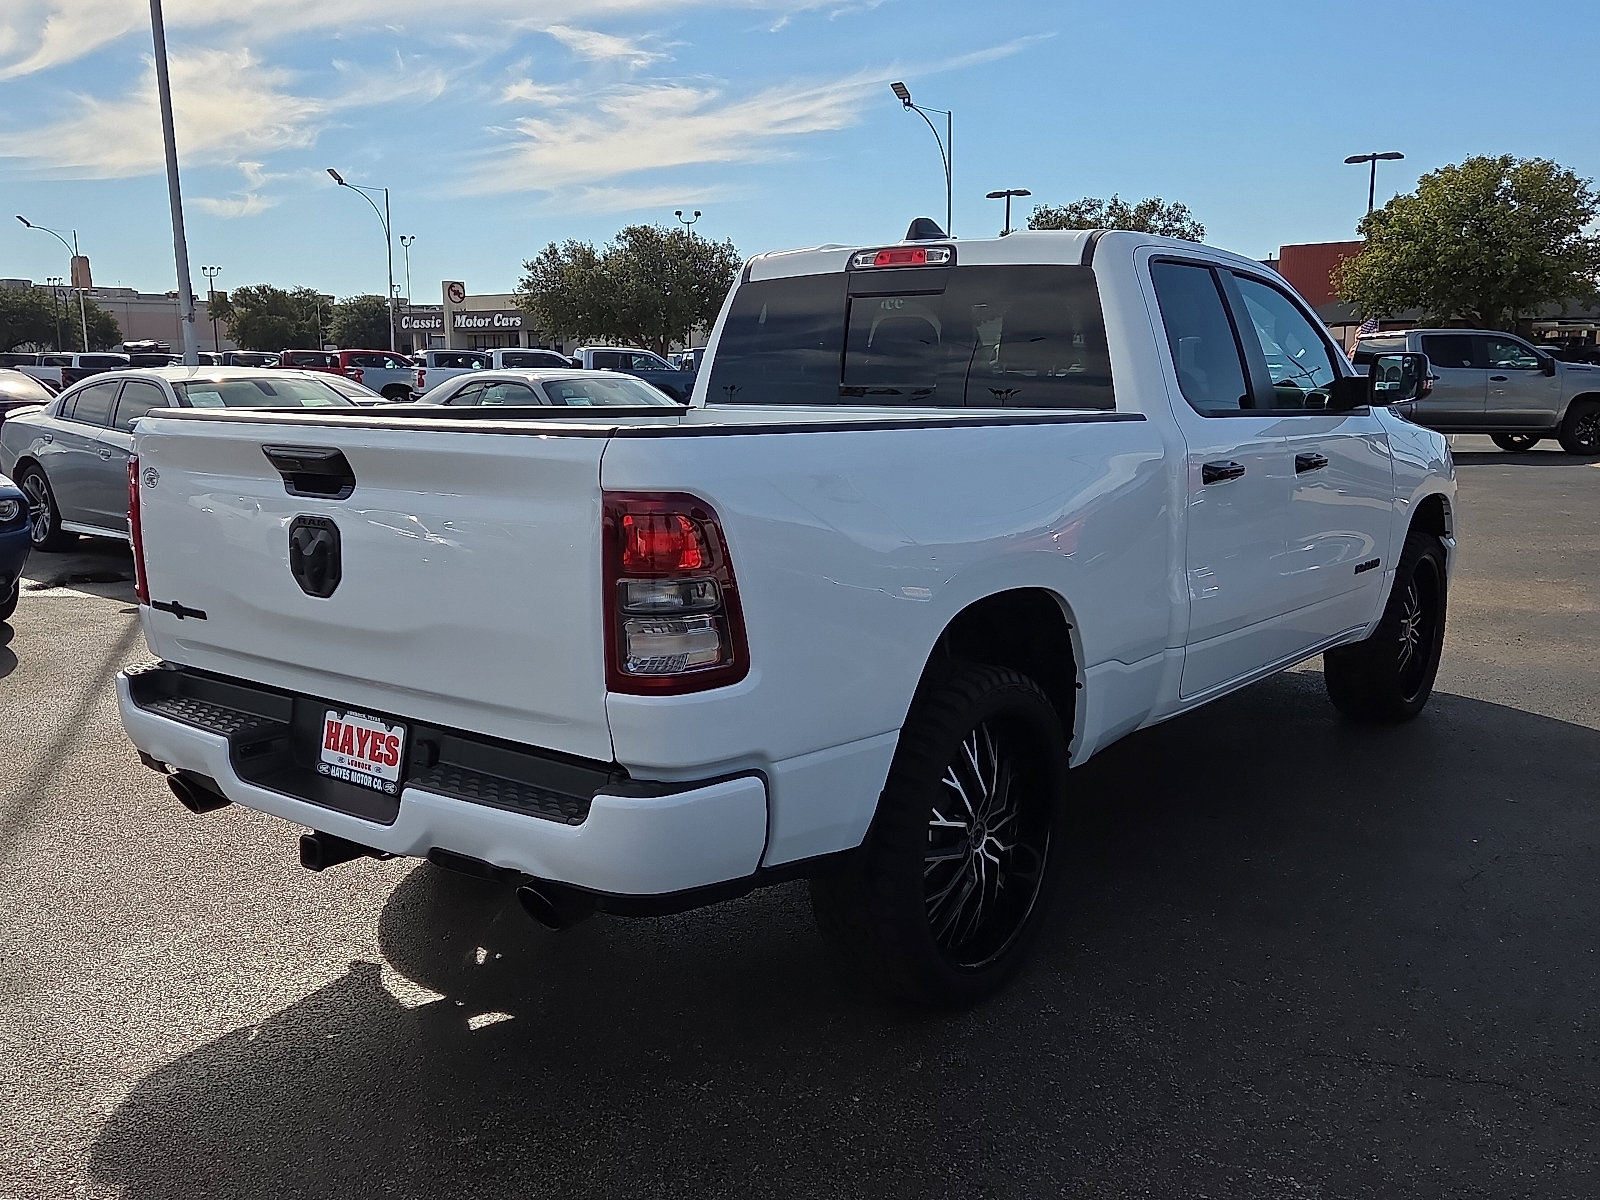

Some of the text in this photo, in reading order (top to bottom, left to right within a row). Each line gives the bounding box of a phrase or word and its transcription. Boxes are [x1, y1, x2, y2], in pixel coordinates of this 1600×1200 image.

[454, 314, 491, 328] Motor
[493, 313, 522, 327] Cars
[324, 720, 399, 767] HAYES
[331, 766, 350, 780] HAYES
[350, 771, 372, 787] MOTOR
